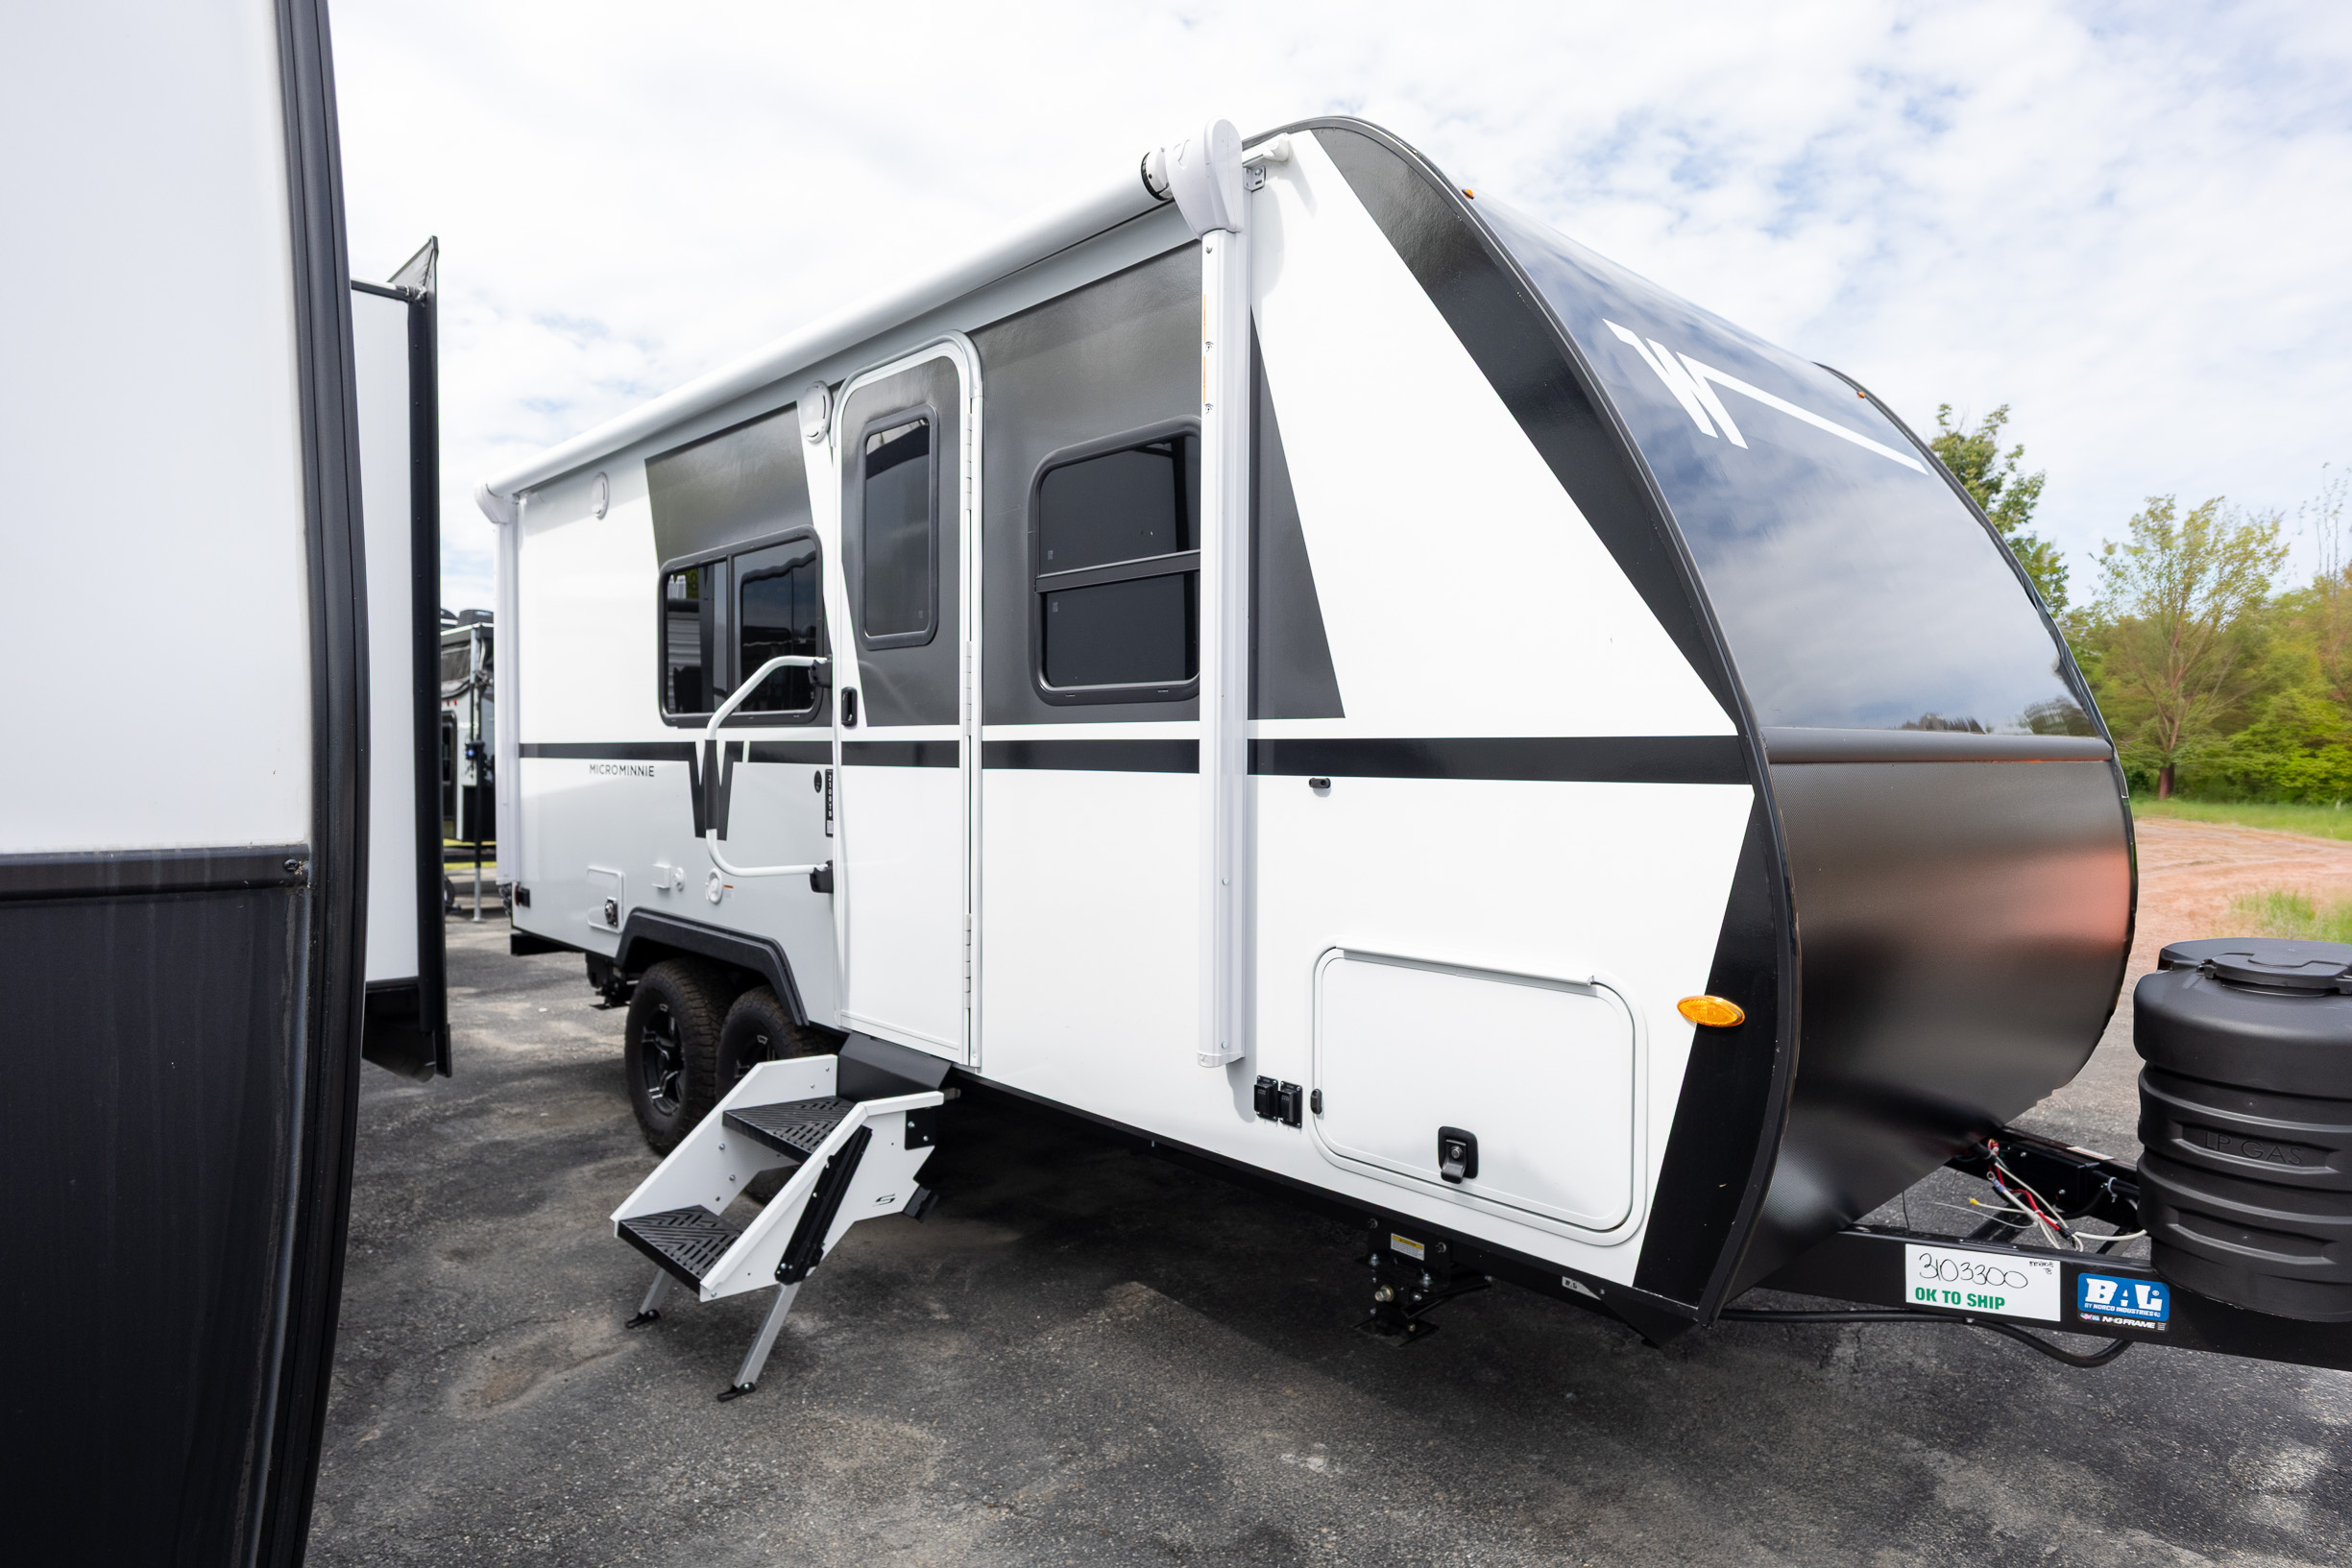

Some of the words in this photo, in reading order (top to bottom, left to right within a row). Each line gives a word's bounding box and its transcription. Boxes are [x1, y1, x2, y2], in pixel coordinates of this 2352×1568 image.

[589, 763, 655, 777] MICROMINNIE
[2205, 1131, 2231, 1151] LP
[2241, 1140, 2302, 1166] GAS
[1919, 1252, 2028, 1289] 3103300
[1915, 1287, 1937, 1302] OK
[1942, 1290, 1961, 1306] TO
[1967, 1293, 2005, 1310] SHIP
[2093, 1303, 2116, 1312] NORCO
[2116, 1306, 2154, 1316] INDUSTRIES
[2122, 1318, 2156, 1329] FRAME
